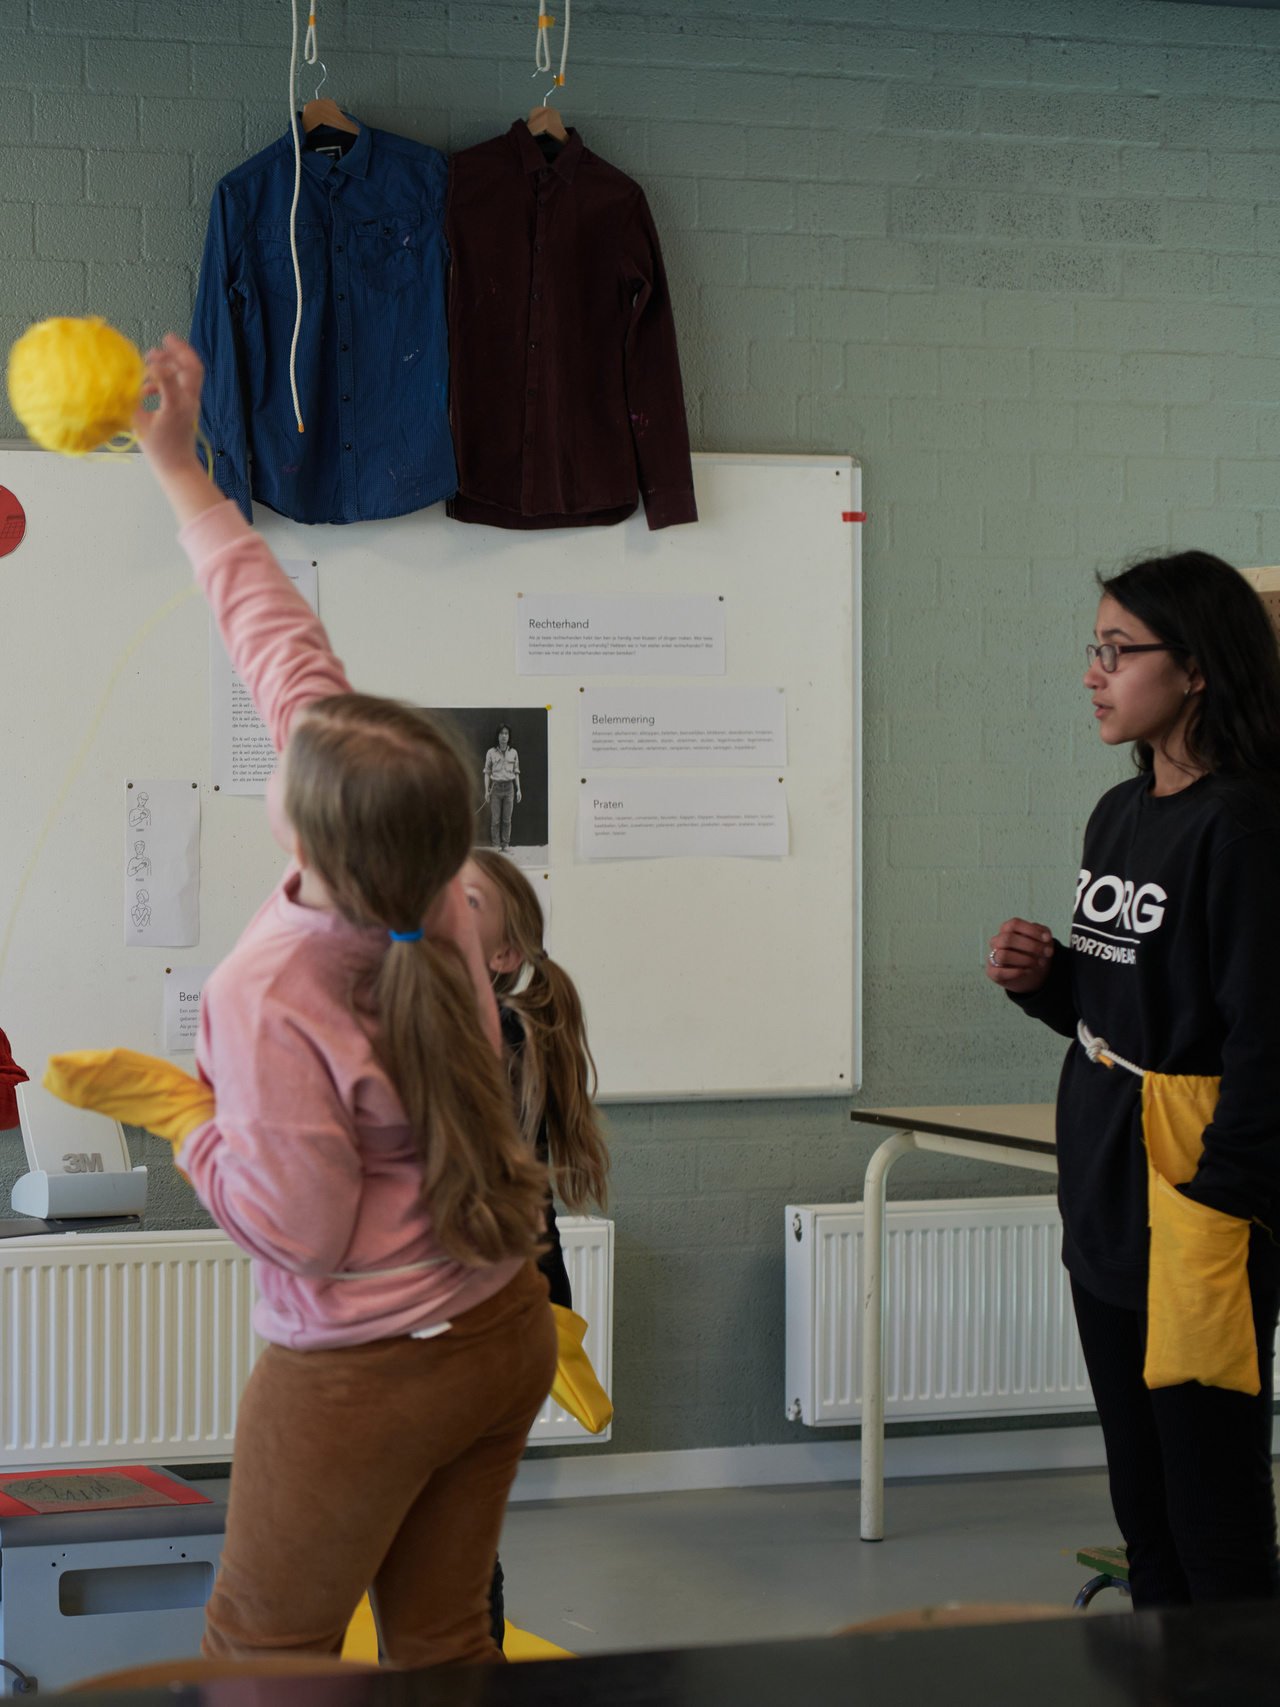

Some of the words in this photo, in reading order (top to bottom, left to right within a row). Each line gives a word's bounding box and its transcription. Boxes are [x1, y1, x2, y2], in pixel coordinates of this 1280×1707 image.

[529, 618, 589, 629] Rechterhand
[592, 714, 655, 727] Belemmering
[593, 799, 624, 809] Praten
[179, 991, 201, 1001] Beel
[62, 1153, 104, 1173] 3M
